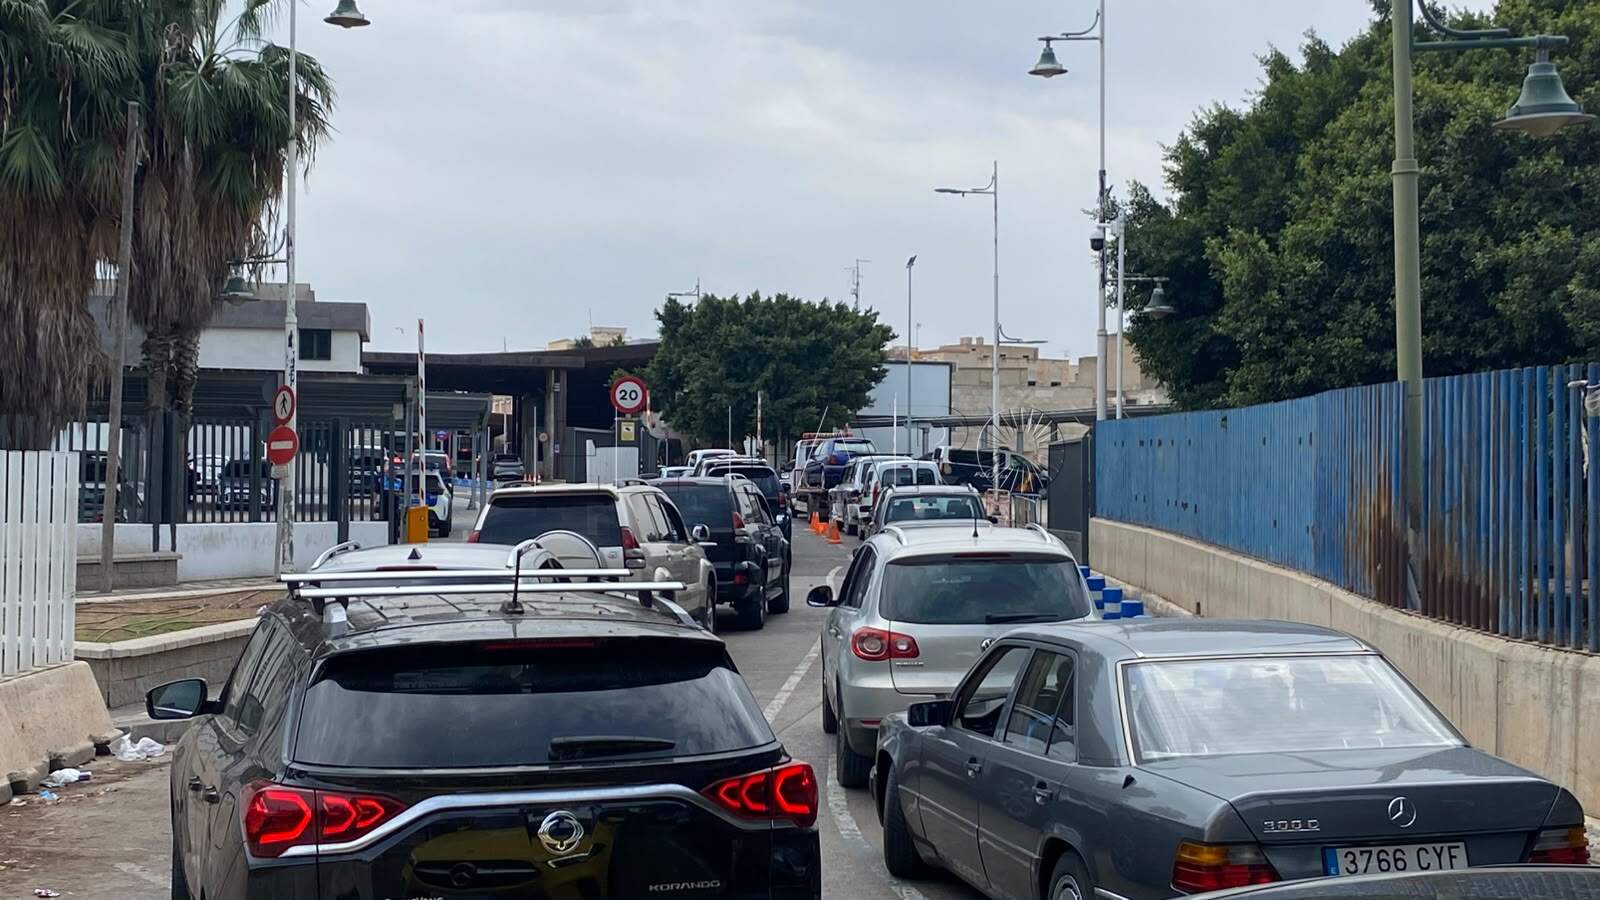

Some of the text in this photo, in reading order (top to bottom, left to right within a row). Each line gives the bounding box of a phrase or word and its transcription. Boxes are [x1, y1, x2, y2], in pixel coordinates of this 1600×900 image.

[619, 389, 638, 401] 20
[1264, 819, 1303, 831] 300
[1343, 844, 1461, 874] 3766 CYF
[648, 880, 720, 892] KORANDO
